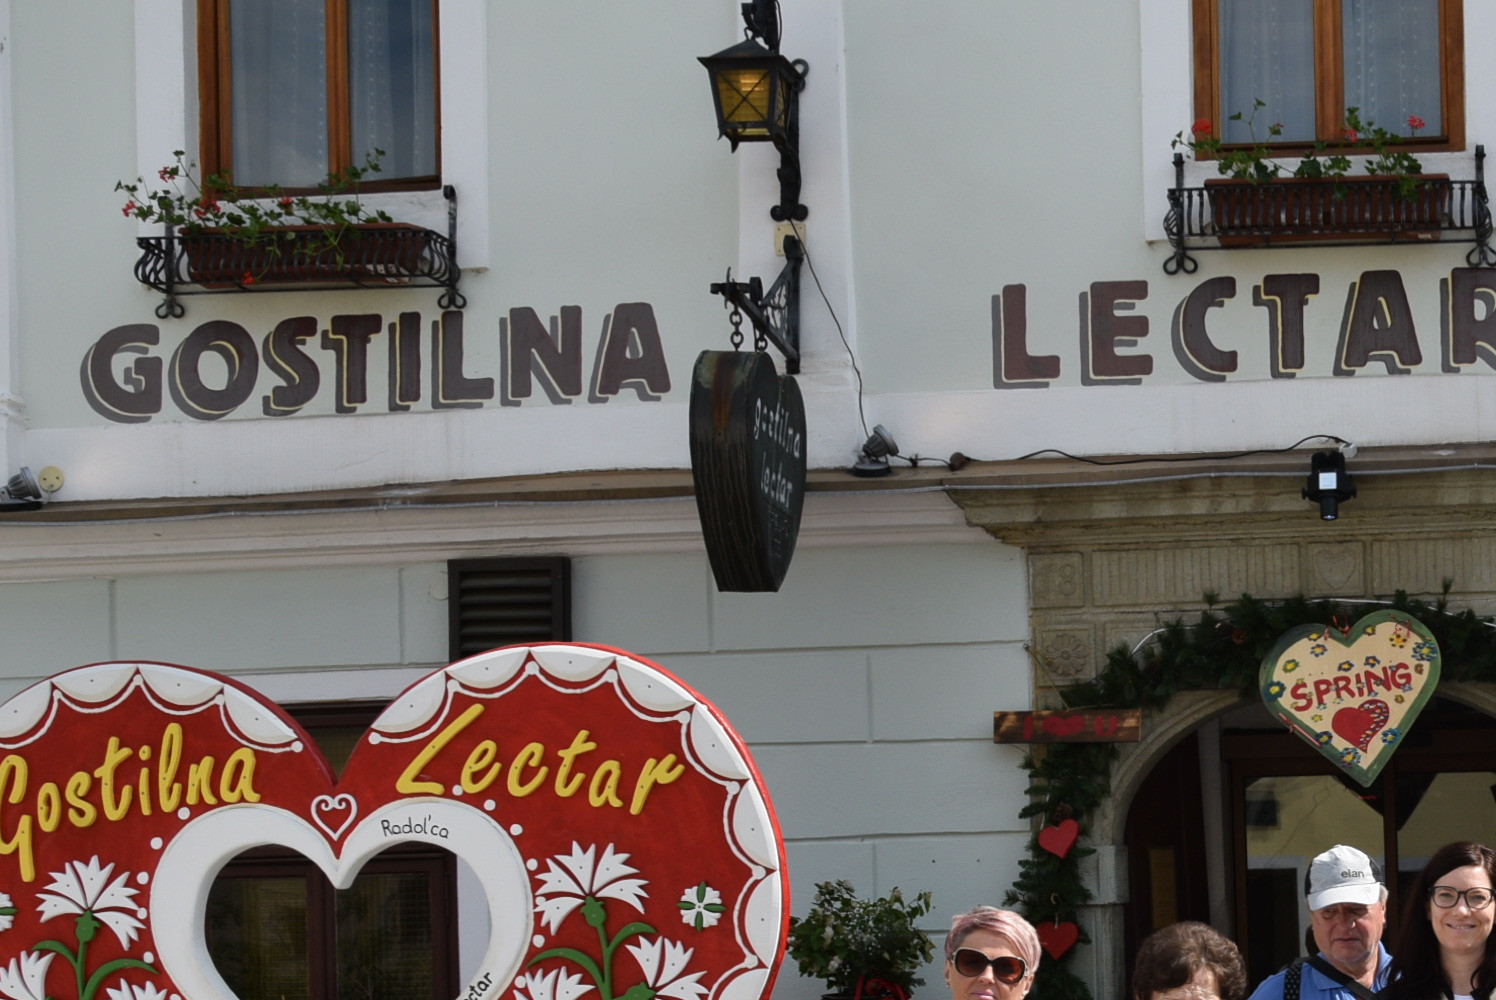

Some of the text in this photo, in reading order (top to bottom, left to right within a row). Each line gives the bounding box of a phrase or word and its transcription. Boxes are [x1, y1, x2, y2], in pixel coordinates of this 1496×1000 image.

[81, 302, 672, 424] GOSTILNA
[753, 397, 800, 459] gostilna
[760, 452, 793, 508] lectar
[1290, 662, 1412, 712] SPRING
[1094, 715, 1119, 738] U
[0, 703, 686, 882] Gostilna Lectar
[381, 814, 449, 839] Radol'ca
[1341, 868, 1365, 878] elan
